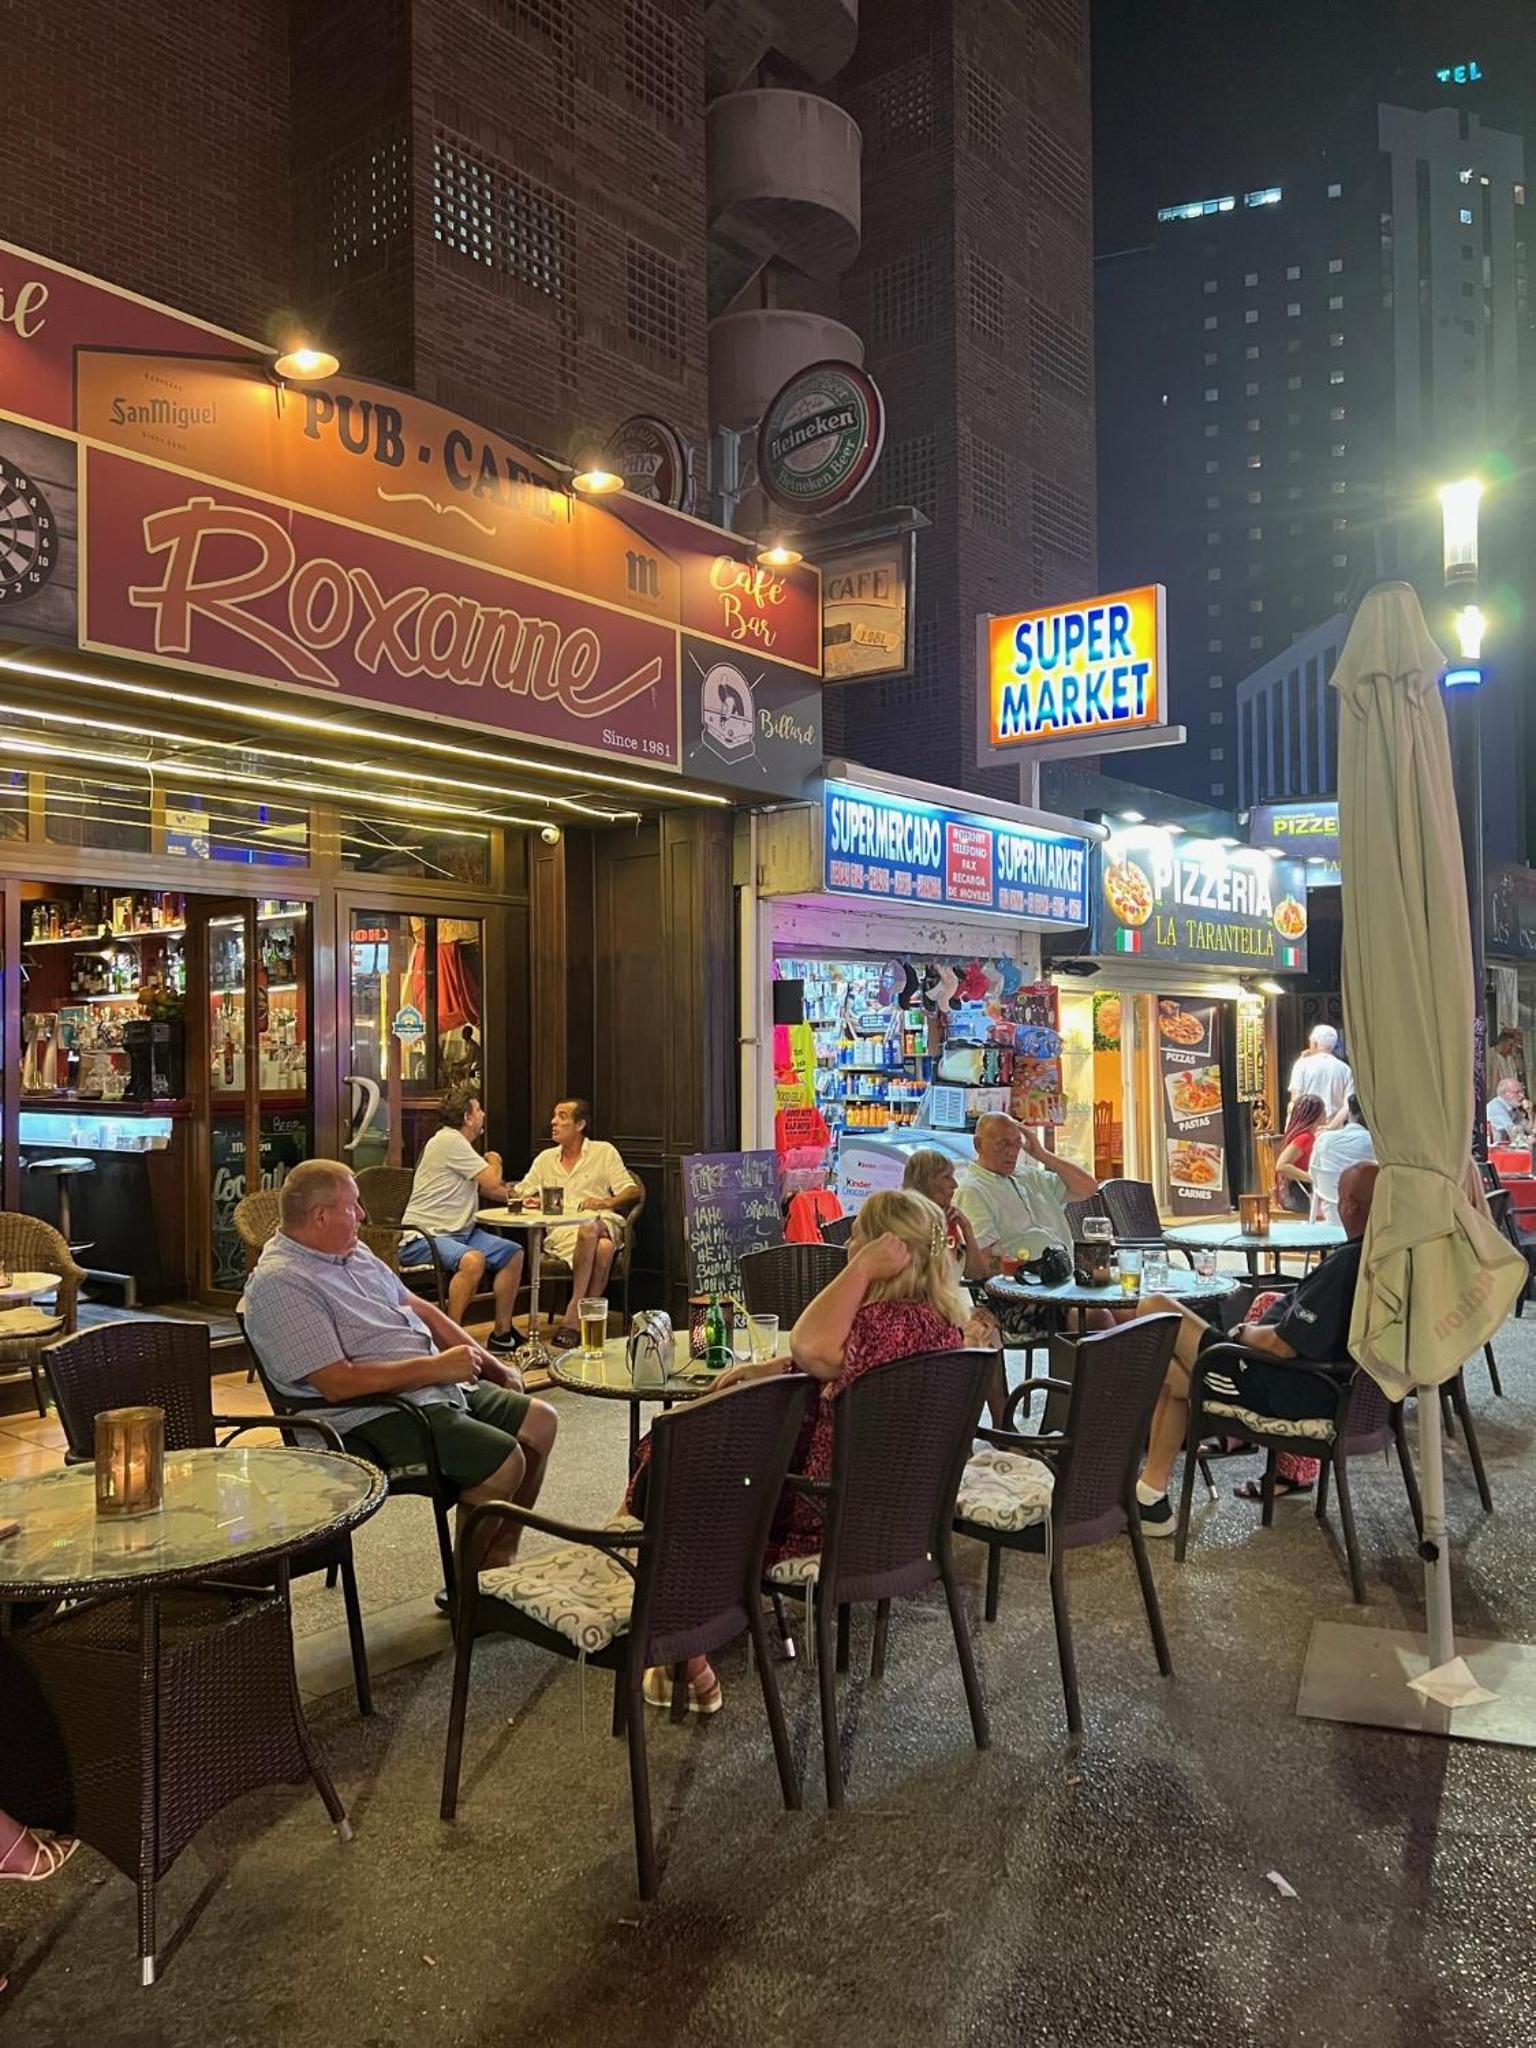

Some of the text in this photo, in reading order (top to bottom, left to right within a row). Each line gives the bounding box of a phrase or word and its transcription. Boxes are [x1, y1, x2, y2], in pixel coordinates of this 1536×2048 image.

[301, 388, 406, 467] PUB
[771, 409, 855, 463] Heineken
[129, 497, 662, 719] Roxanne
[718, 591, 777, 647] Bar
[1014, 604, 1132, 676] SUPER
[758, 708, 817, 741] Billard
[1000, 661, 1150, 736] MARKET
[602, 728, 671, 757] Since 1981
[831, 796, 942, 869] SUPERMERCADO
[1273, 816, 1339, 837] PIZZE
[997, 833, 1083, 894] SUPERMARKET
[1154, 858, 1274, 918] PIZZERIA
[948, 886, 991, 903] DE MOVILES
[1156, 916, 1275, 957] LA TARANTELLA
[1165, 1052, 1196, 1065] PIZZAS
[1179, 1117, 1211, 1133] PASTAS
[1178, 1187, 1212, 1200] CARNES
